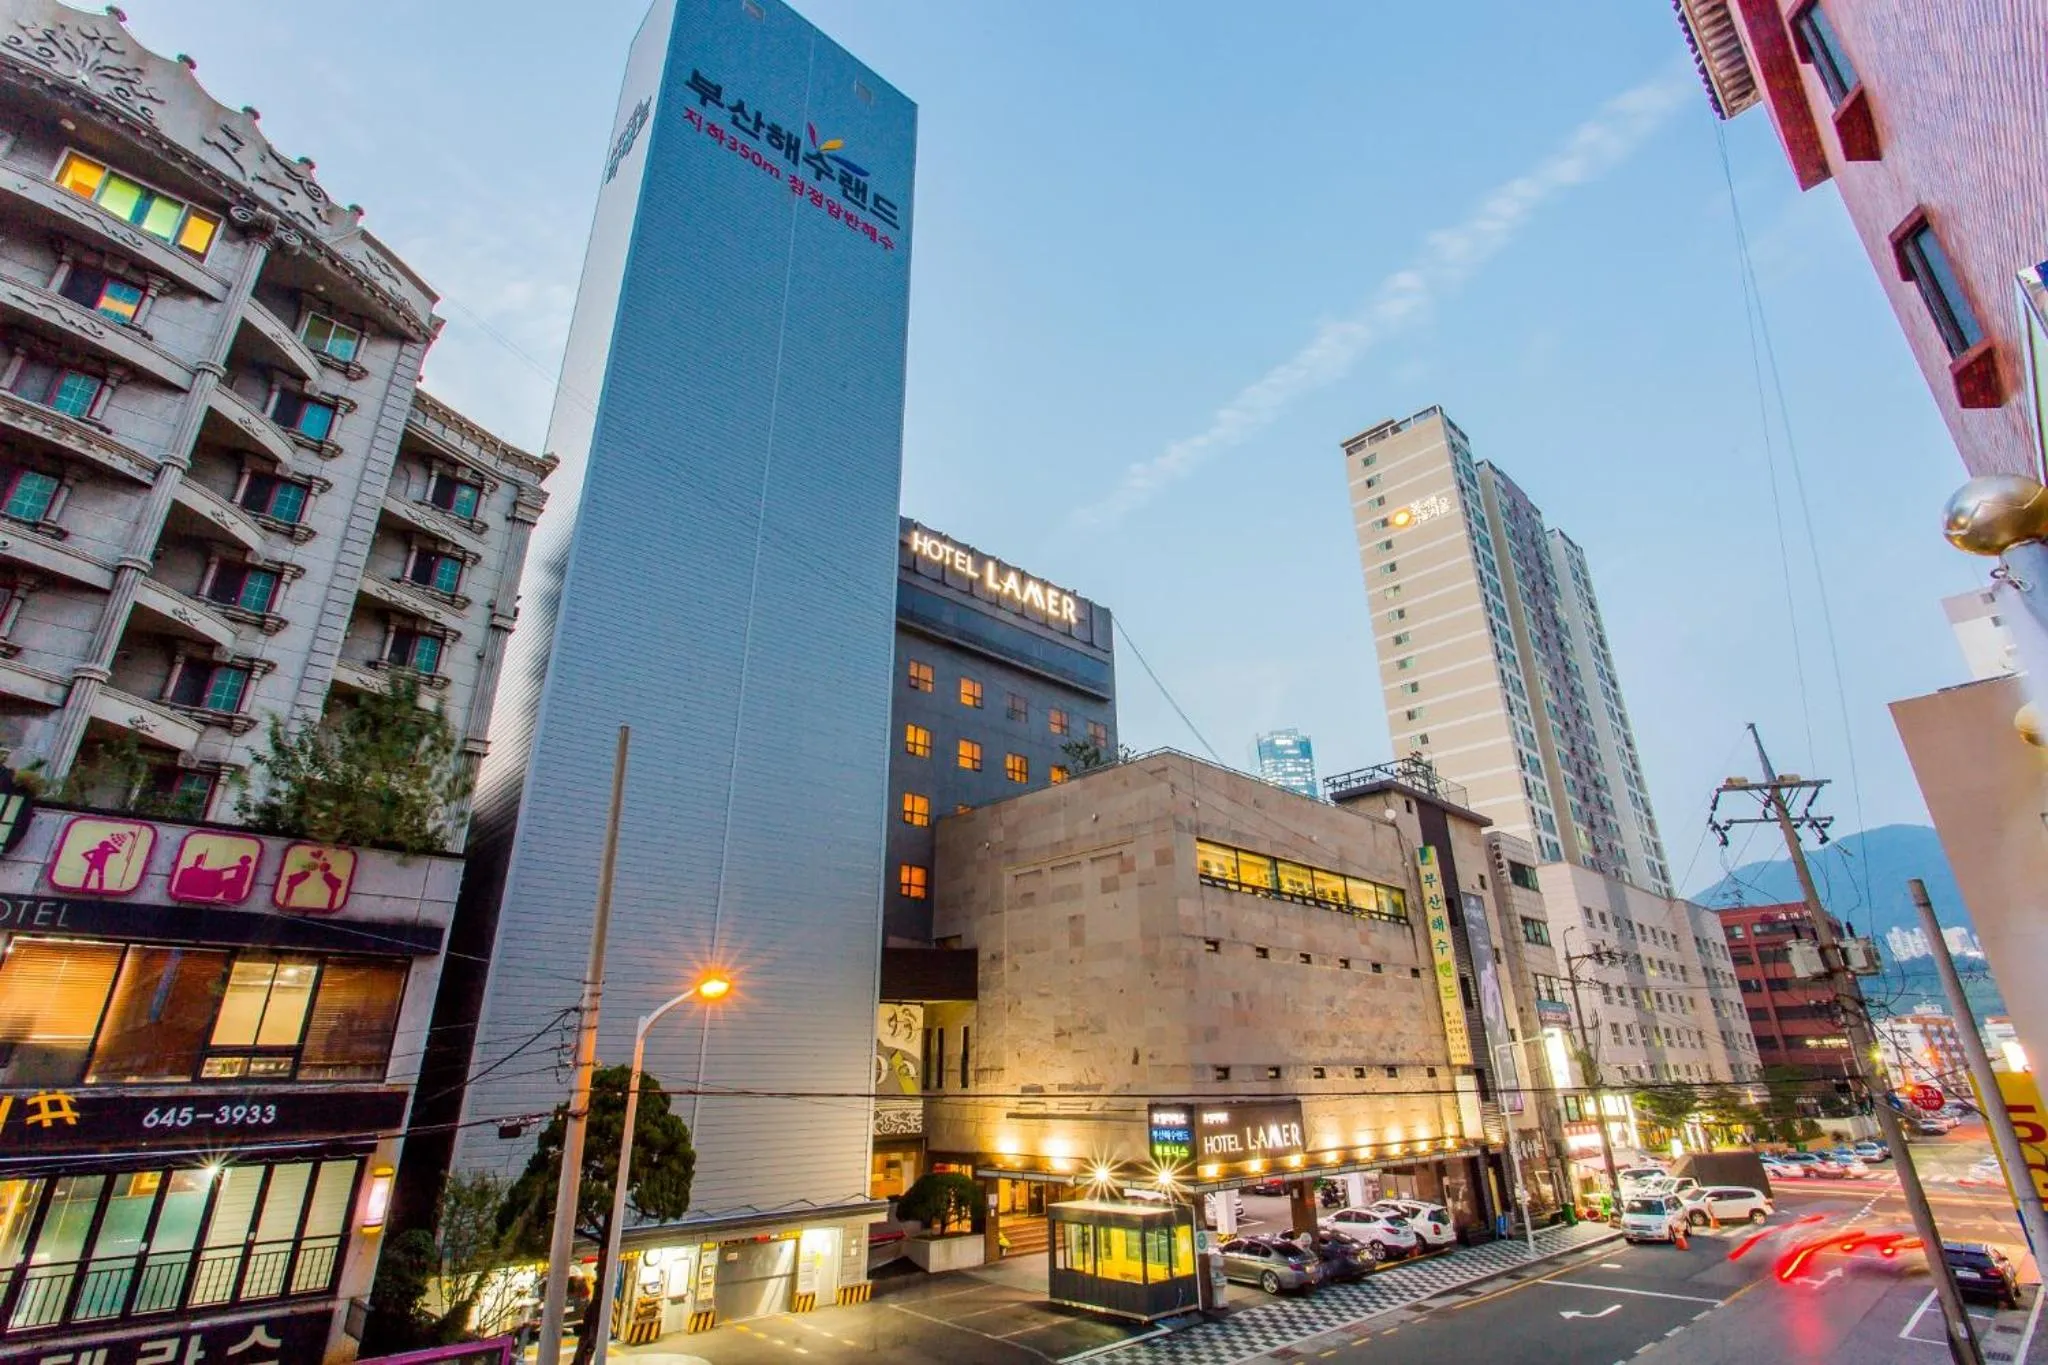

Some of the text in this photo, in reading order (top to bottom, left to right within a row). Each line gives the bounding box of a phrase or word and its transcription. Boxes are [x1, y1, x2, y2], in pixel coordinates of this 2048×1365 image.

[683, 106, 781, 180] 지하350m
[685, 69, 900, 230] 부산해수랜드
[912, 531, 1078, 624] HOTEL LAMER
[1423, 873, 1457, 998] 부산해수랜드
[142, 1105, 276, 1128] 645-3933
[1204, 1124, 1302, 1154] HOTEL LAMER
